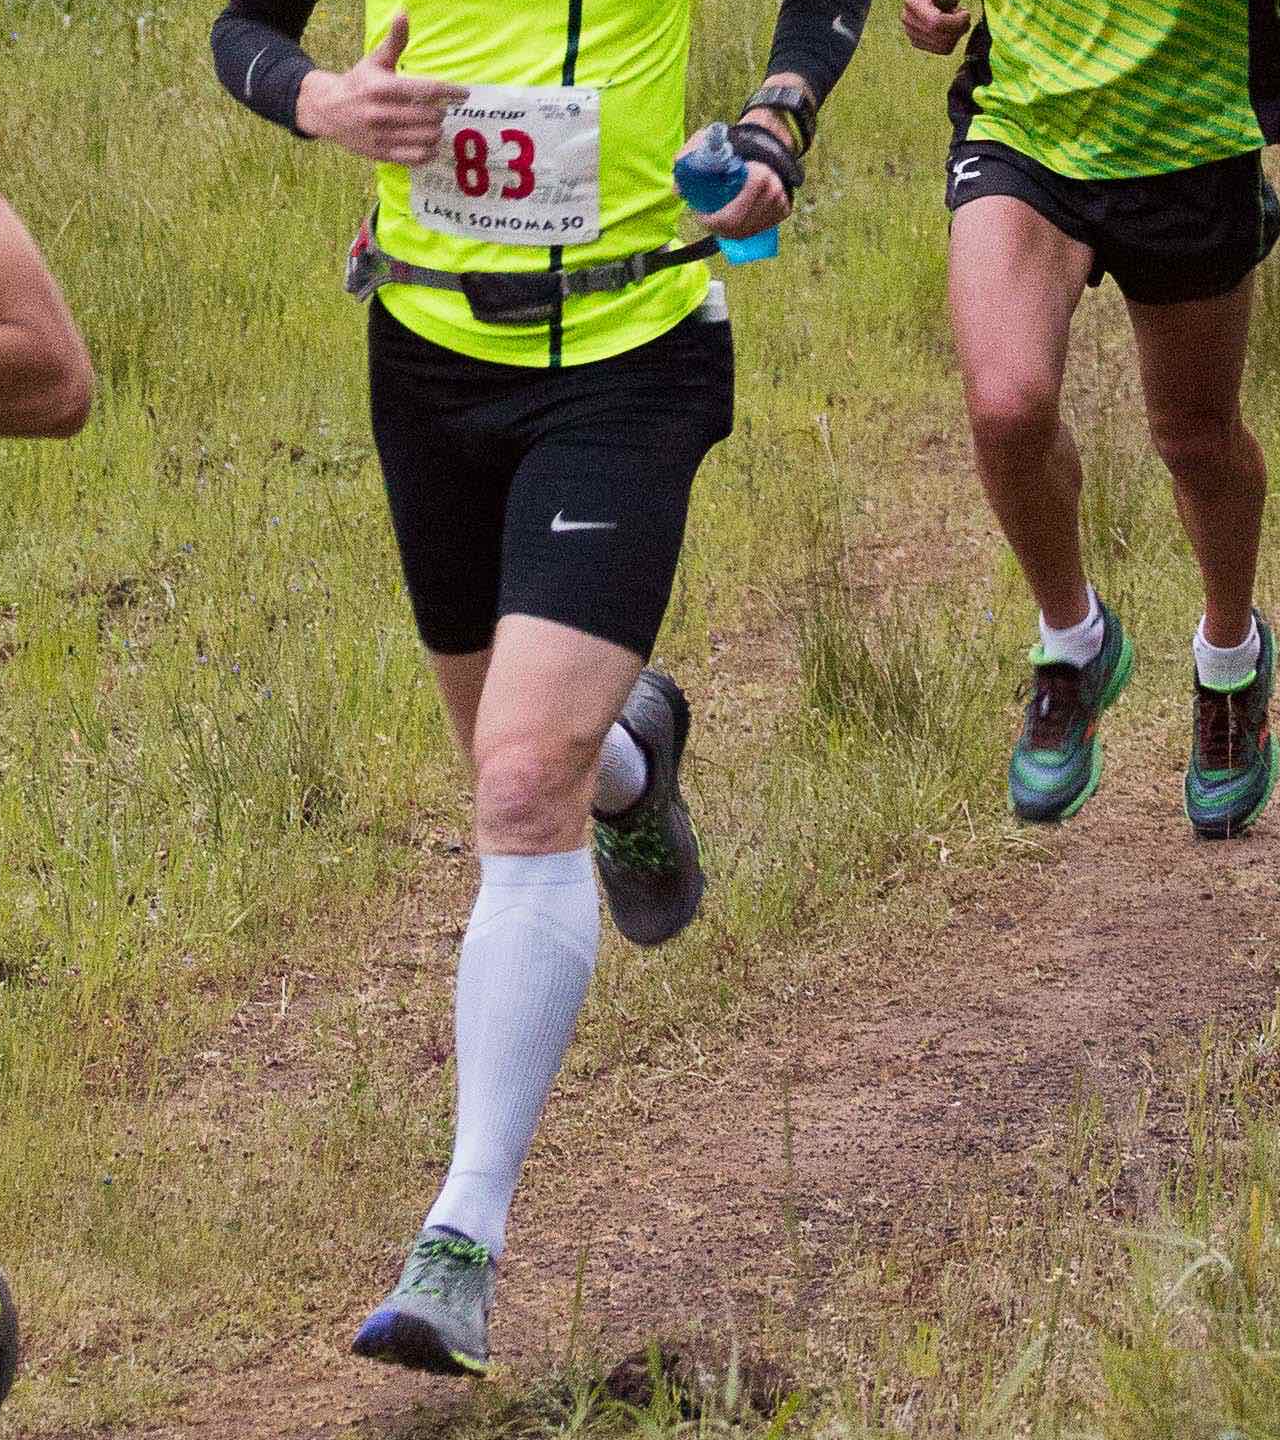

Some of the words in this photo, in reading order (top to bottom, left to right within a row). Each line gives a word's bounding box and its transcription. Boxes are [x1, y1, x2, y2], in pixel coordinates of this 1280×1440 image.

[489, 109, 526, 119] CUP
[454, 128, 536, 200] 83
[469, 213, 554, 231] SONOMA
[561, 215, 584, 232] 50
